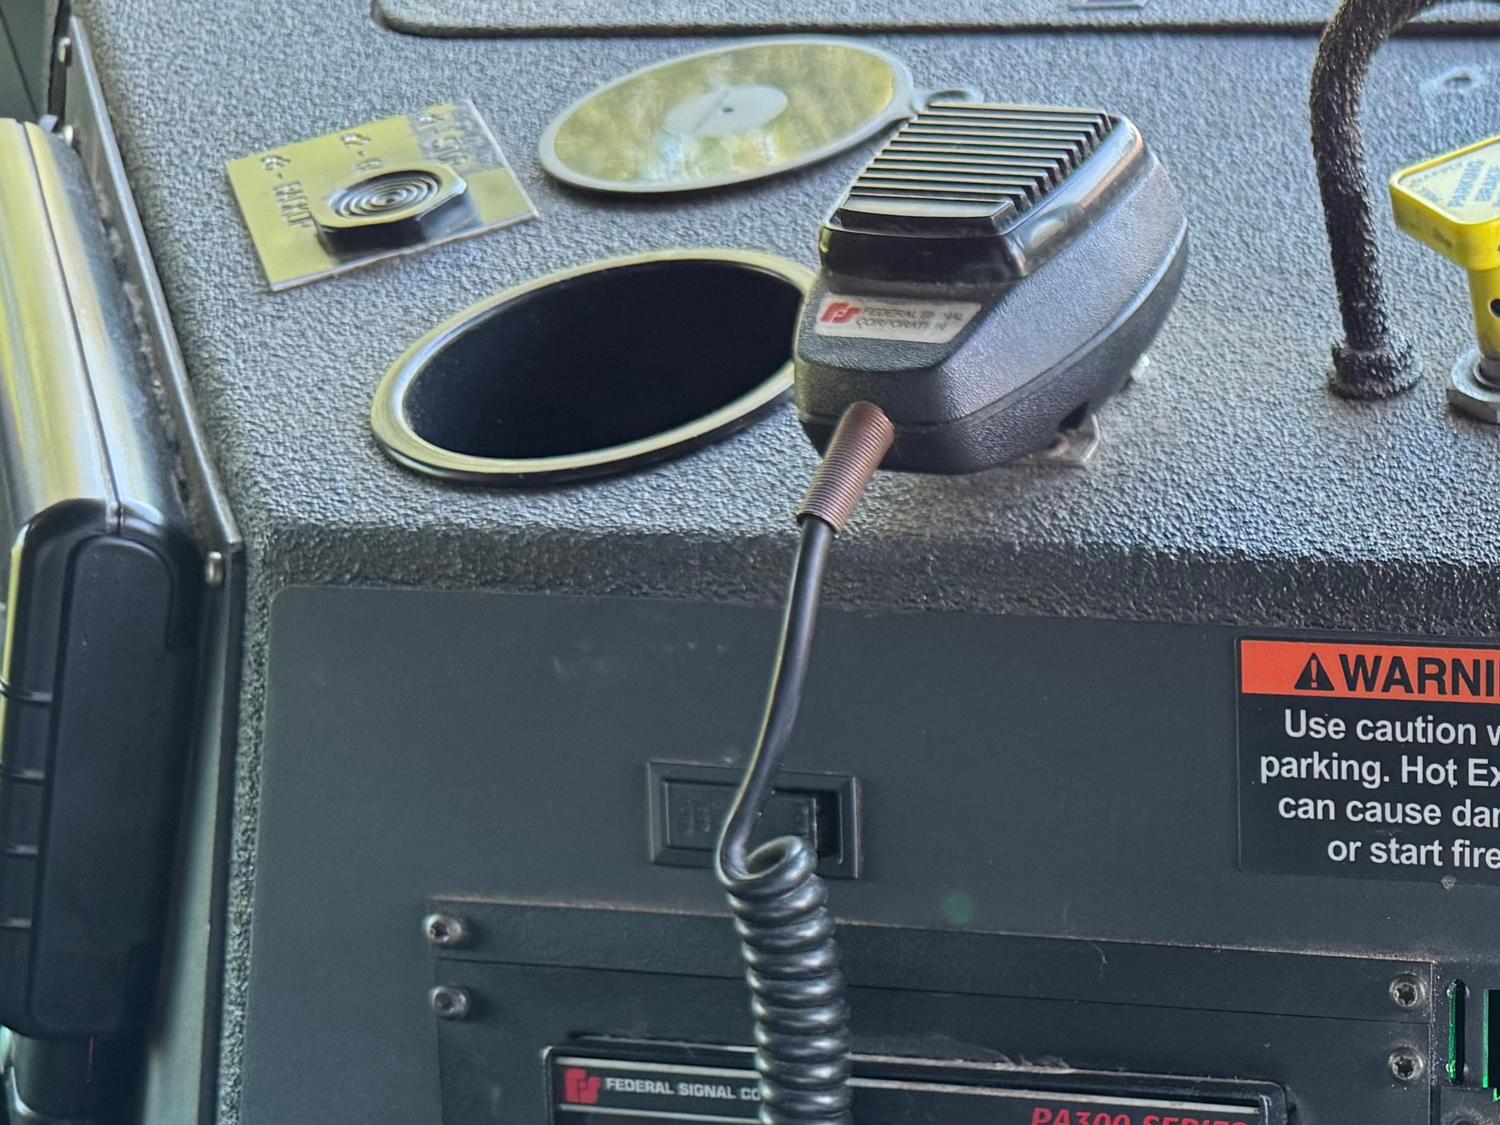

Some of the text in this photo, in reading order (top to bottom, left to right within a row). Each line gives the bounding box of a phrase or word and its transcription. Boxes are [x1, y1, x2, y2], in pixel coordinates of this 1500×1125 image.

[855, 317, 948, 330] CORPORATIN
[861, 306, 917, 319] FEDERAL
[1284, 709, 1346, 739] Use
[1357, 714, 1478, 745] caution
[1260, 751, 1390, 789] parking.
[1401, 755, 1458, 786] Hot
[1278, 797, 1336, 821] can
[1345, 801, 1442, 826] cause
[1327, 839, 1361, 862] or
[1369, 837, 1443, 867] start
[606, 1077, 675, 1095] FEDERAL
[678, 1082, 737, 1099] SIGNAL
